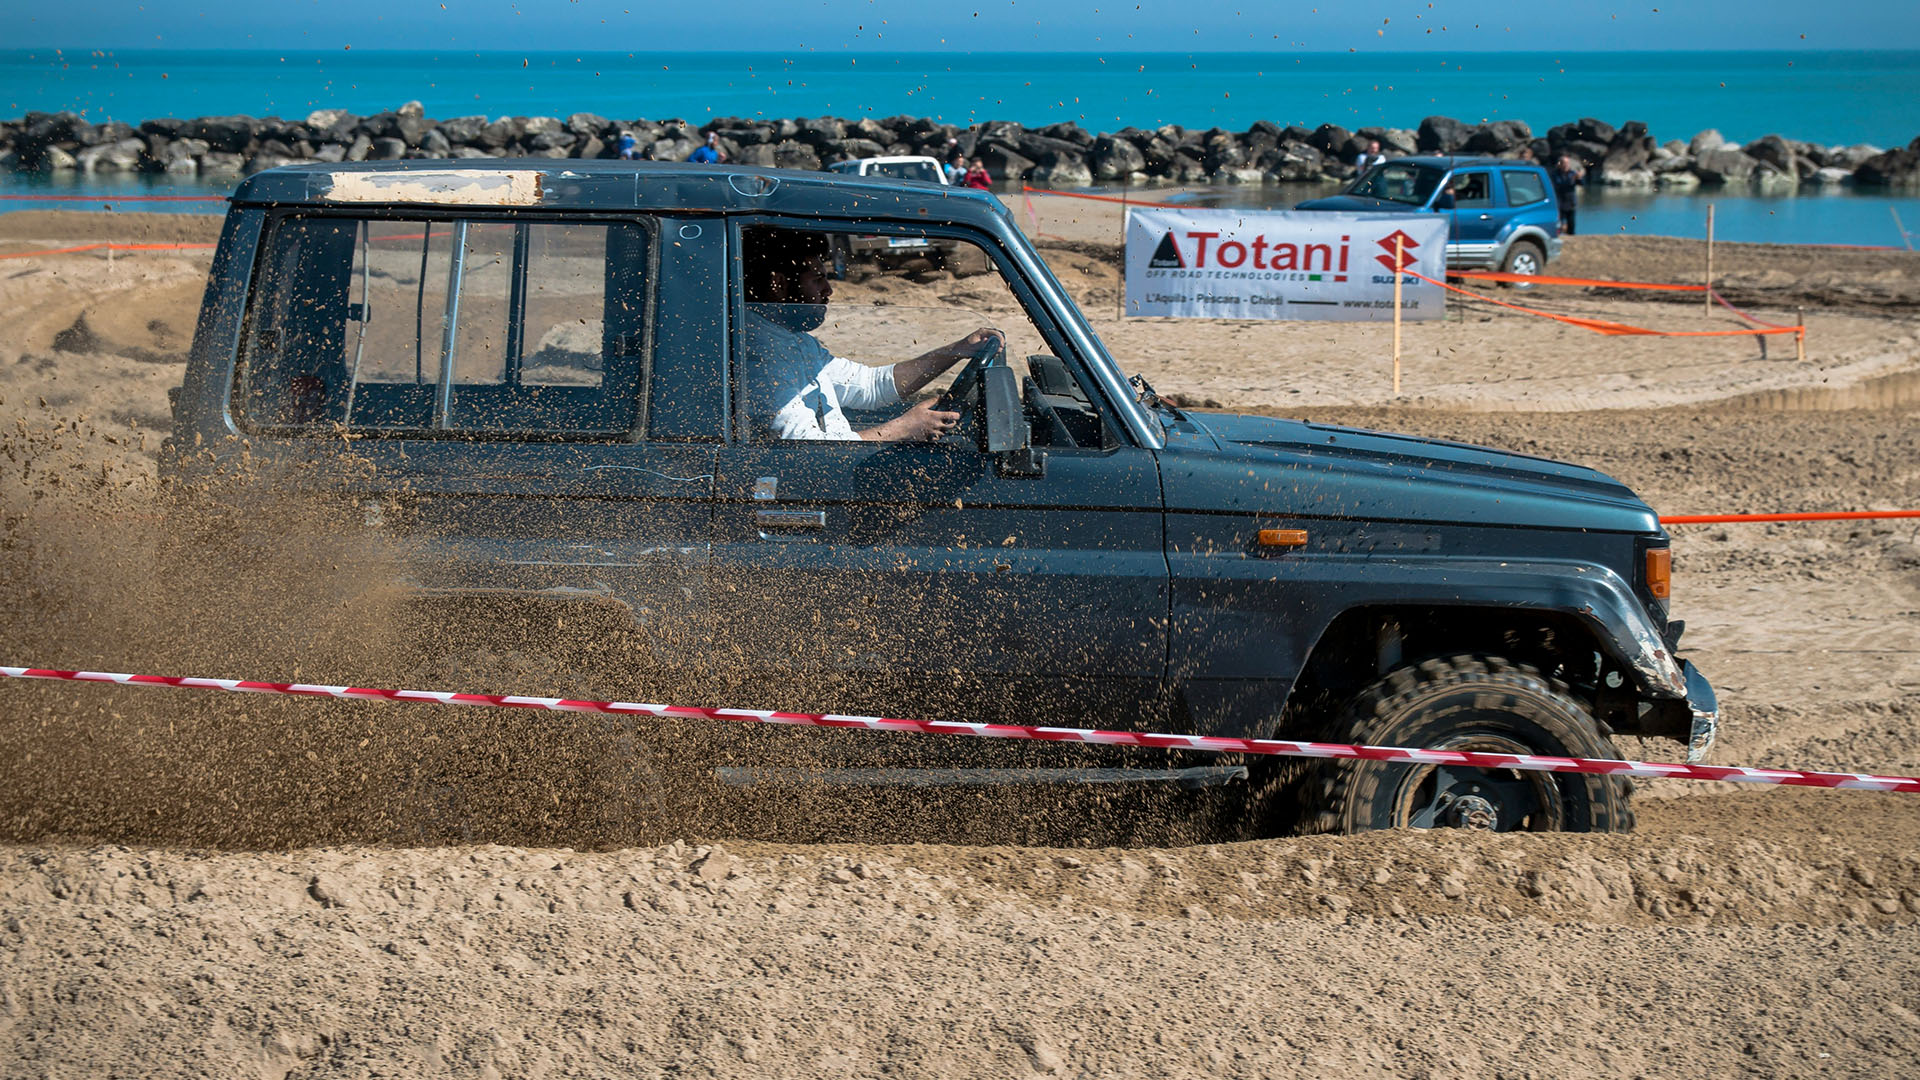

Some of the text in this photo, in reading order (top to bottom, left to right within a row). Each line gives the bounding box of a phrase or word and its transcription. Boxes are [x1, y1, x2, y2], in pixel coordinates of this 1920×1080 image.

[1187, 232, 1350, 272] Totani
[1207, 271, 1305, 281] TECHNOLOGIES
[1196, 293, 1240, 304] Pescara
[1250, 294, 1283, 305] Chieti
